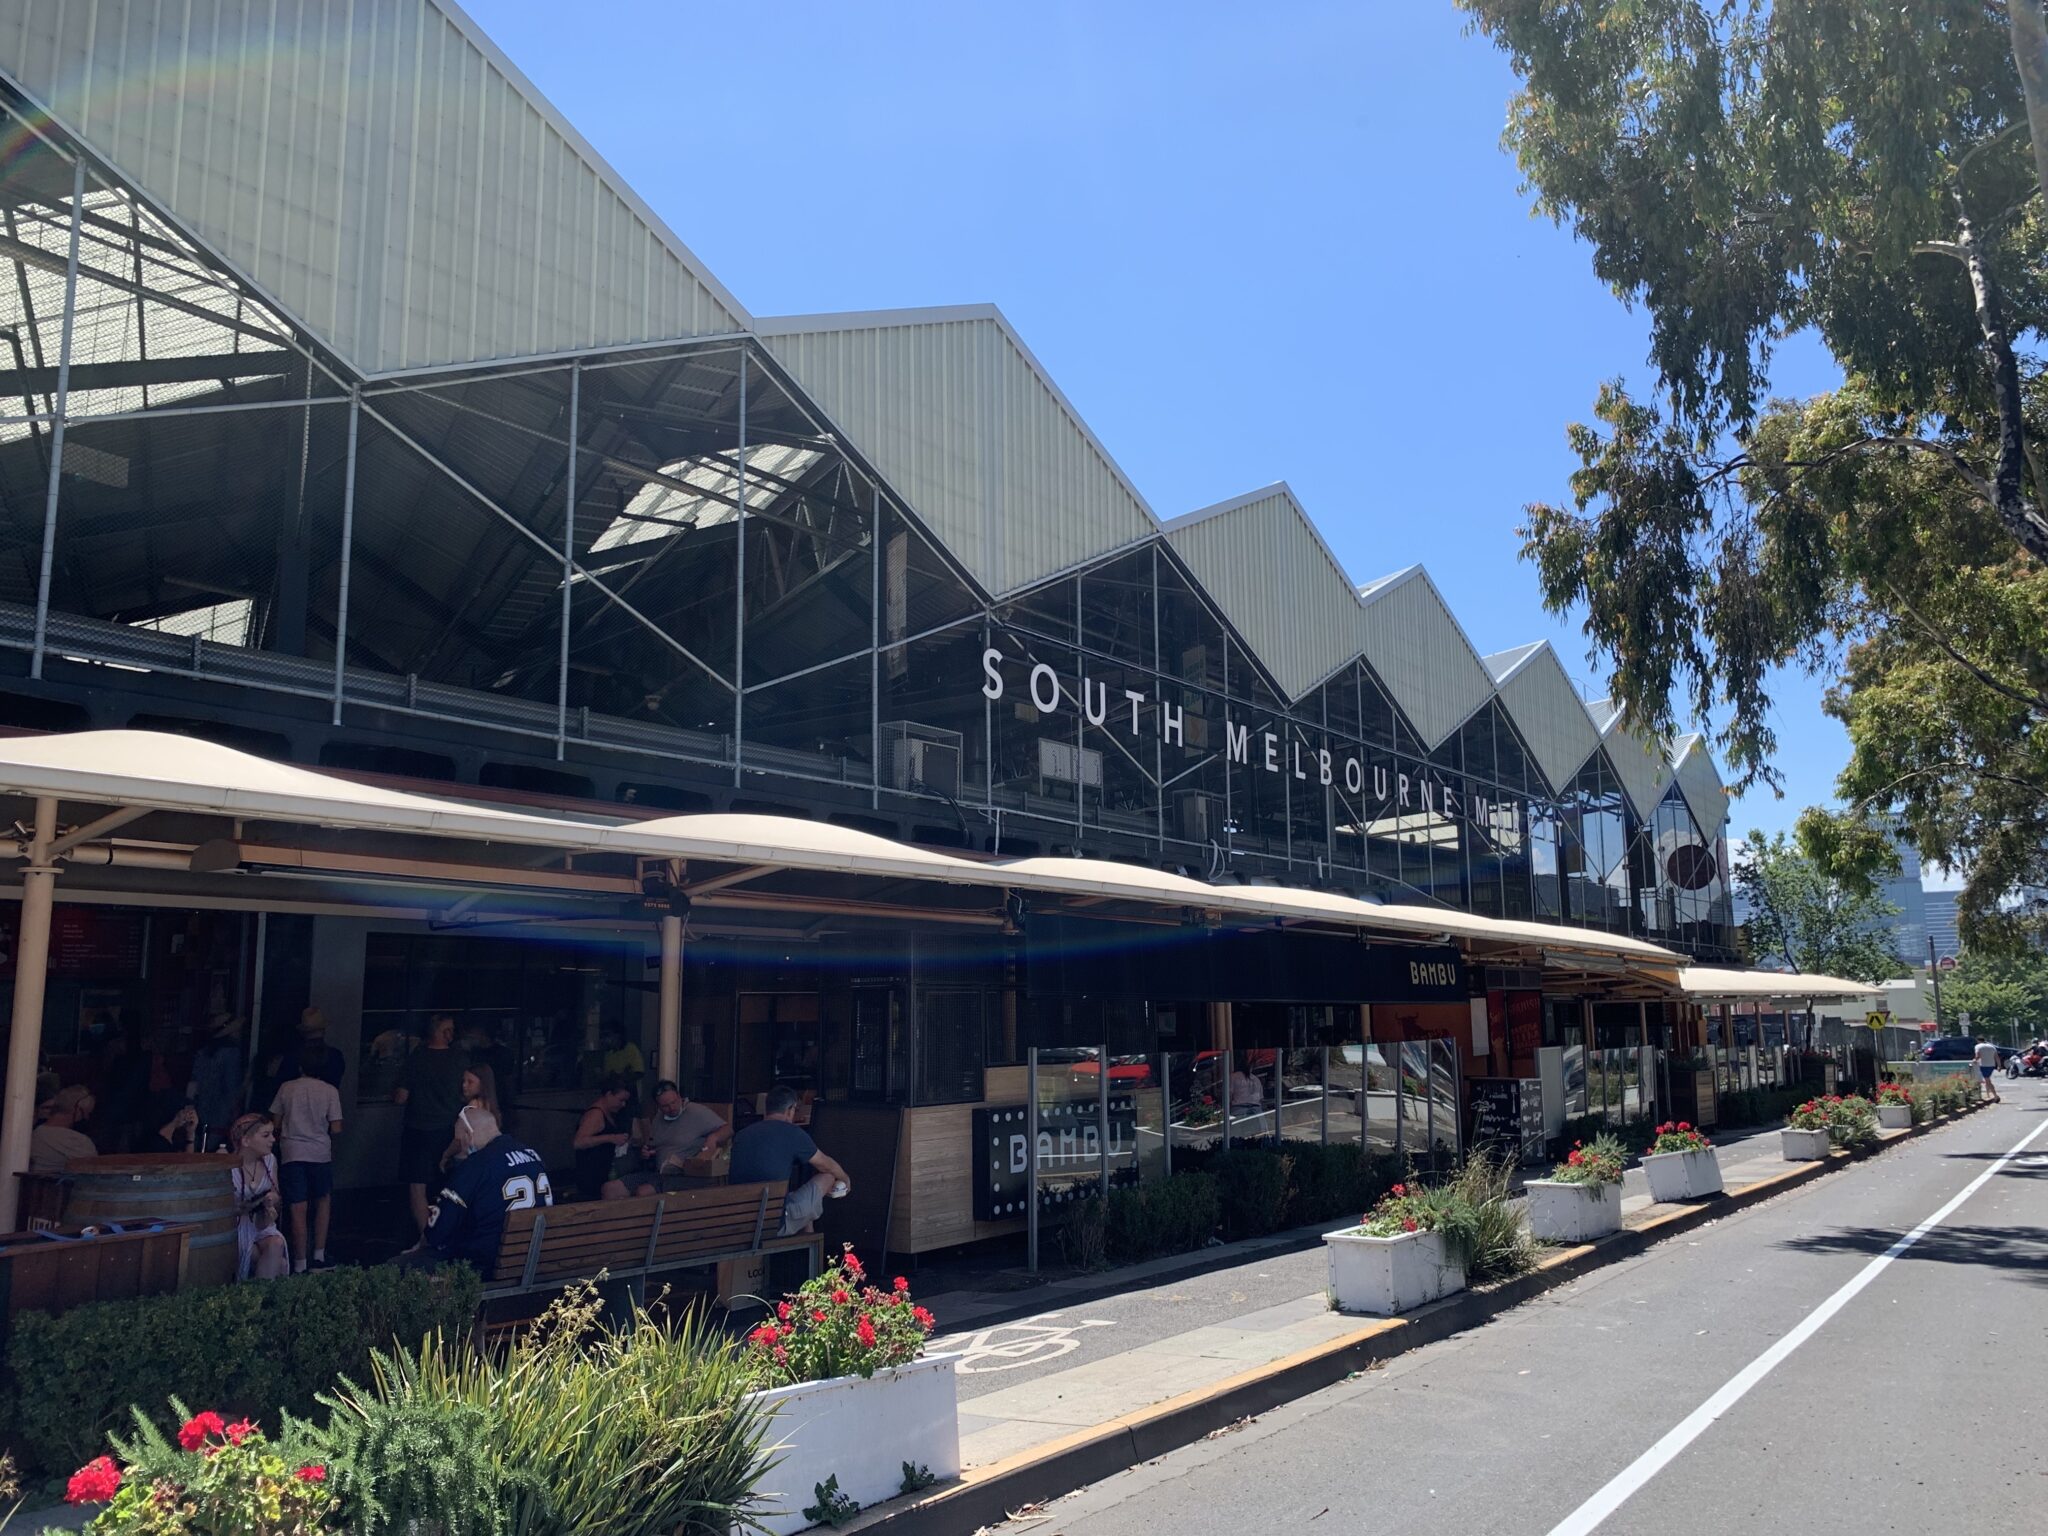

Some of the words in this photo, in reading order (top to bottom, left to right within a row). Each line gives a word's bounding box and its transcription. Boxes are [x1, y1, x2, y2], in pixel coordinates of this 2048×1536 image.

[982, 648, 1183, 748] SOUTH
[1226, 721, 1455, 818] MELBOURNE
[1410, 961, 1456, 986] BAMBU
[1009, 1121, 1121, 1174] BAMBU
